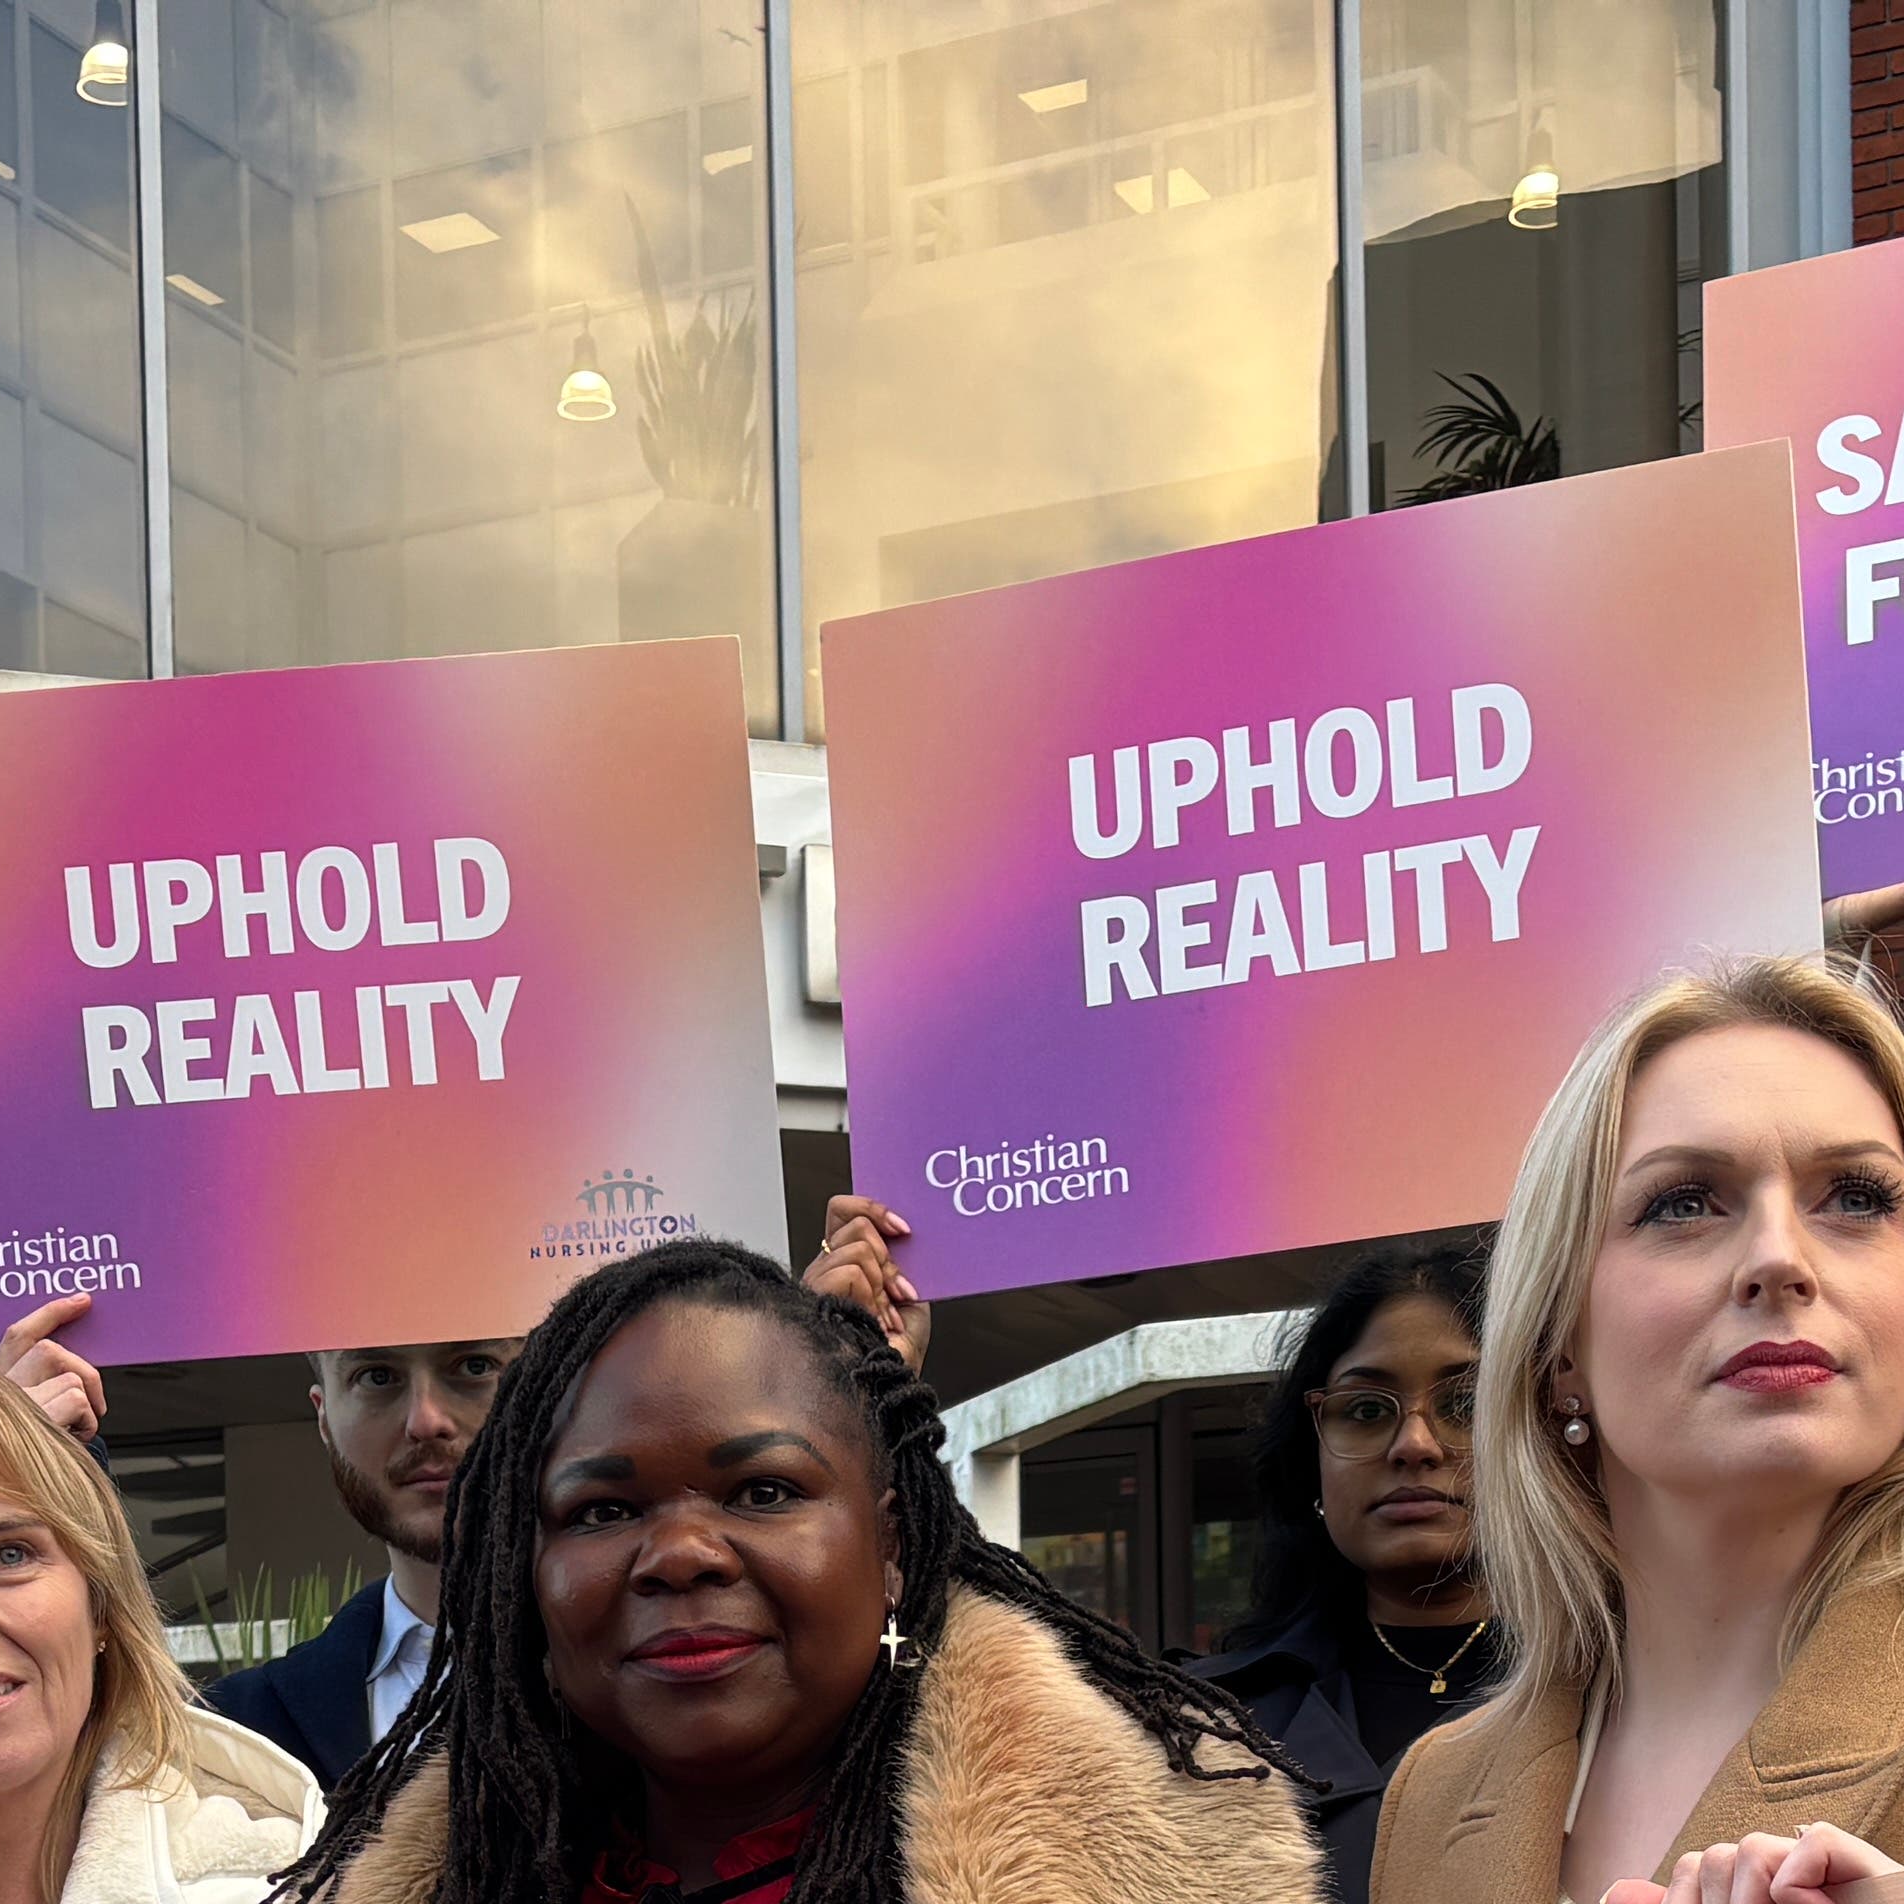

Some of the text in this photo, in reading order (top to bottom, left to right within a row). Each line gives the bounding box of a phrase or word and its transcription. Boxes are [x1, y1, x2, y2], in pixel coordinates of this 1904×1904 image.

[1068, 683, 1533, 859] UPHOLD
[64, 837, 511, 968] UPHOLD
[1080, 825, 1542, 1008] REALITY
[82, 975, 521, 1109] REALITY
[925, 1134, 1108, 1188] Christian
[953, 1166, 1129, 1216] Concern
[530, 1240, 626, 1259] NURSING
[543, 1213, 696, 1243] DARLINGTON
